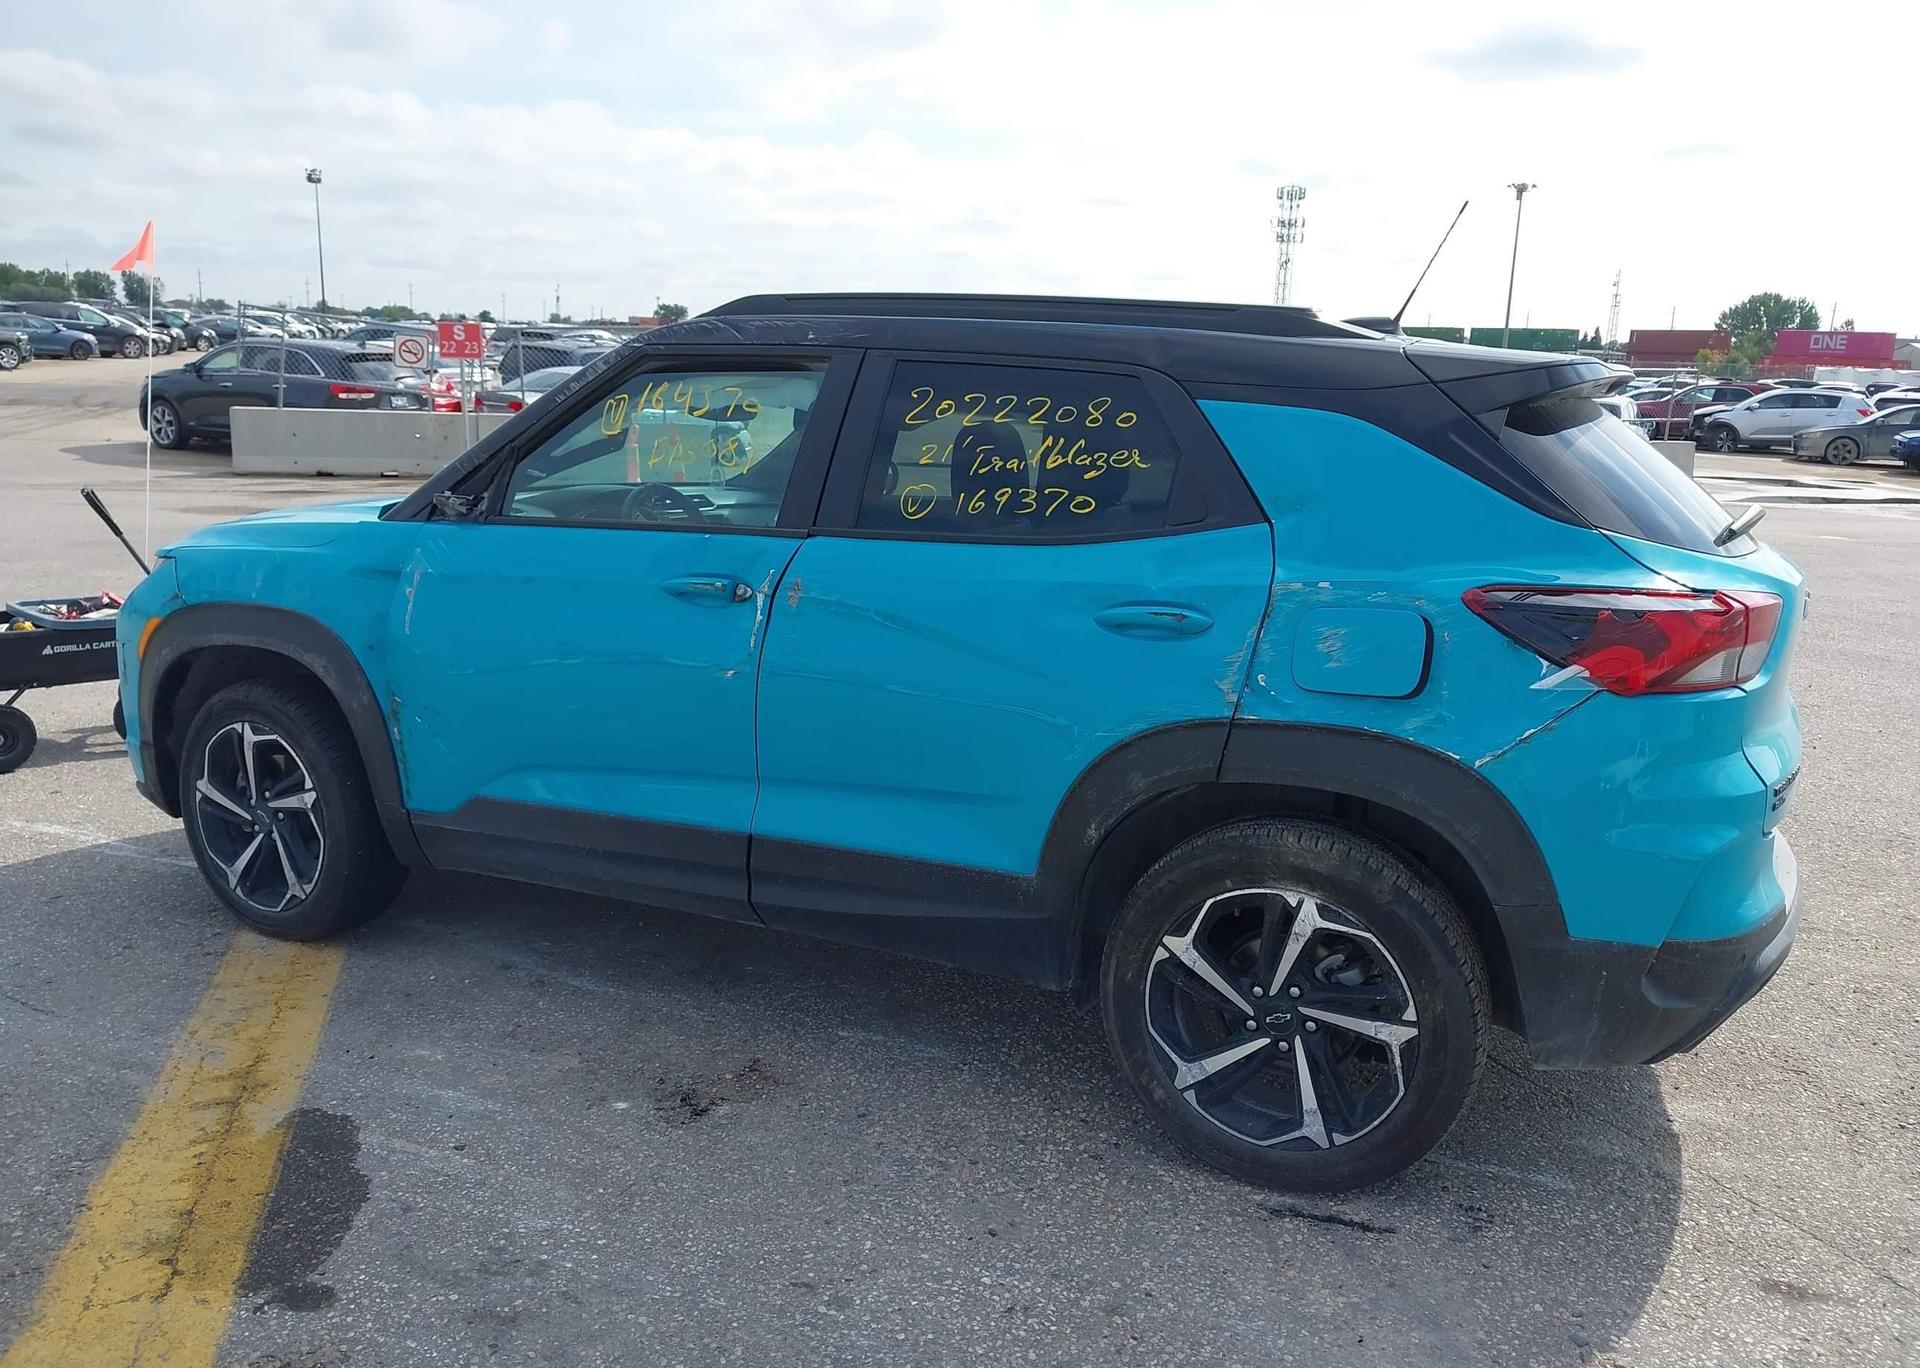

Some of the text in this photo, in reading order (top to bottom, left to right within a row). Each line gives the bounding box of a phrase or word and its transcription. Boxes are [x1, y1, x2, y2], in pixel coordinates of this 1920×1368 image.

[453, 325, 465, 340] S
[442, 341, 479, 353] 22 23
[1809, 334, 1848, 349] ONE
[904, 387, 1138, 428] 20222080
[969, 435, 1151, 479] Trailblazer
[955, 487, 1097, 517] 169370
[54, 640, 116, 653] GORILLA CART
